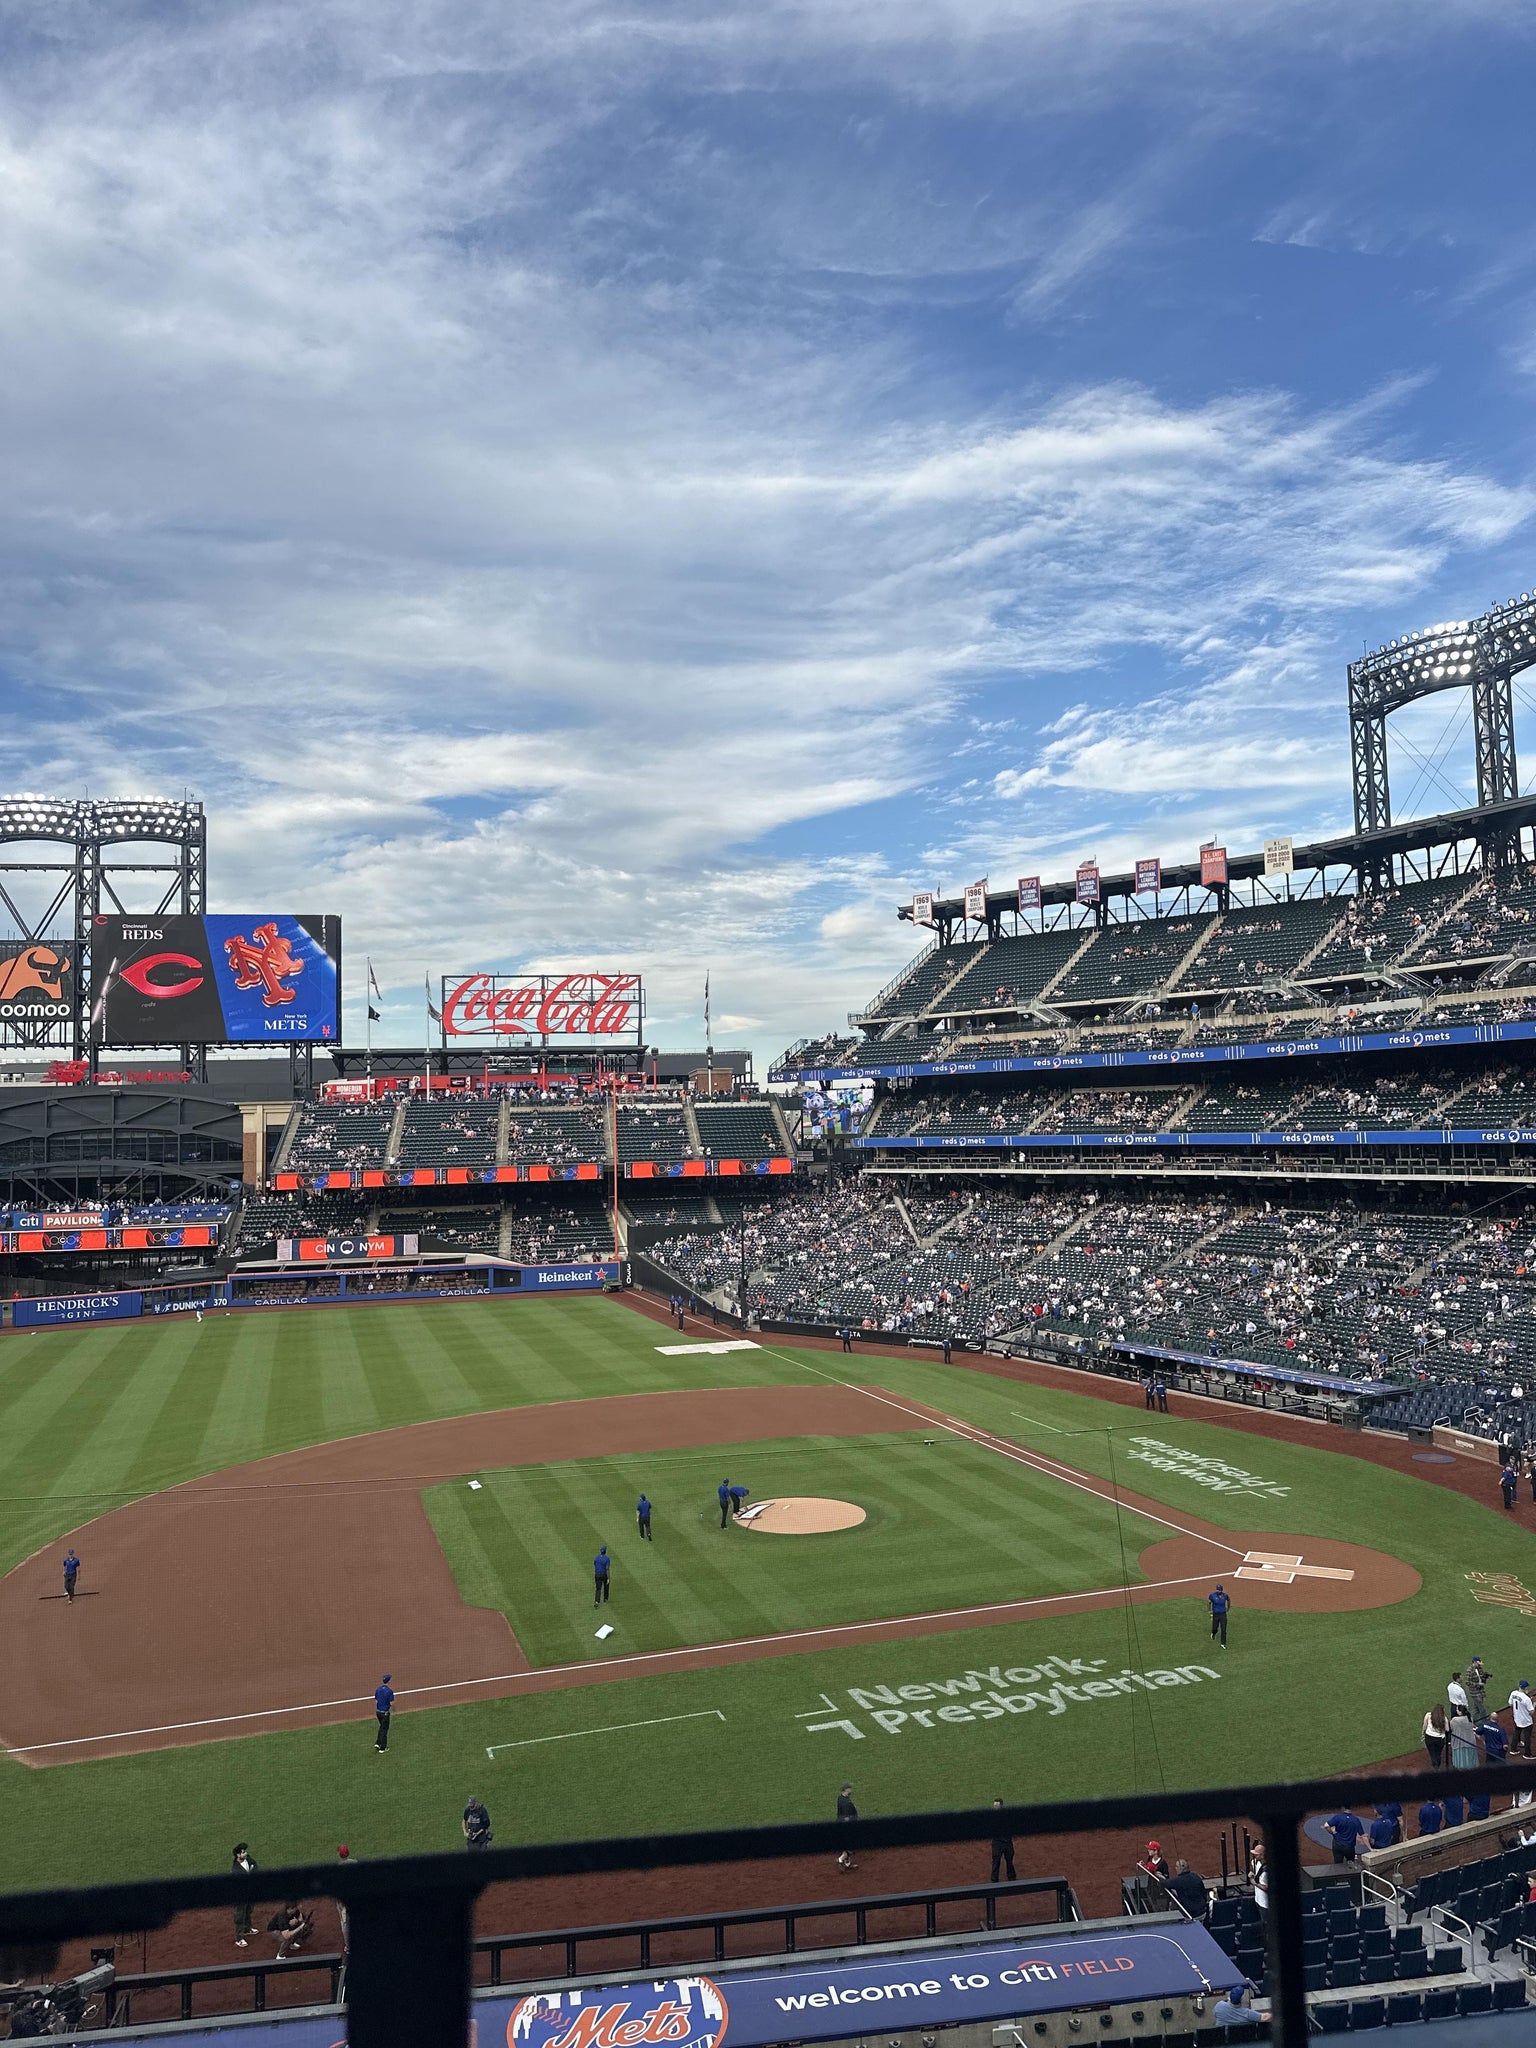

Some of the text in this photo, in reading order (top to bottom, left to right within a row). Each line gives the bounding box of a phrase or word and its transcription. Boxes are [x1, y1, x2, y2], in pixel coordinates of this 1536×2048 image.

[1139, 862, 1156, 871] 2015
[968, 889, 981, 897] 1986
[123, 929, 163, 940] REDS
[442, 974, 641, 1035] Coca-Cola
[264, 1020, 307, 1030] METS
[1389, 1032, 1450, 1044] reds mets
[1267, 1042, 1319, 1053] reds mets
[1149, 1051, 1204, 1061] reds mets
[932, 1063, 948, 1072] reds
[1033, 1057, 1083, 1067] reds mets
[92, 1070, 190, 1082] new balance
[1104, 1135, 1157, 1143] reds mets
[1282, 1133, 1334, 1142] reds mets
[1482, 1130, 1505, 1140] reds
[20, 1215, 98, 1226] citi PAVILION
[315, 1242, 384, 1253] CIN NYM
[538, 1271, 591, 1283] Heineken
[440, 1288, 490, 1296] CADILLAC
[37, 1297, 119, 1312] HENDRICK'S
[1129, 1437, 1277, 1486] Presbyterian
[870, 1663, 1222, 1734] Presbyterian
[774, 1957, 1134, 2012] welcome to citi FIELD
[543, 2000, 692, 2048] Mets
